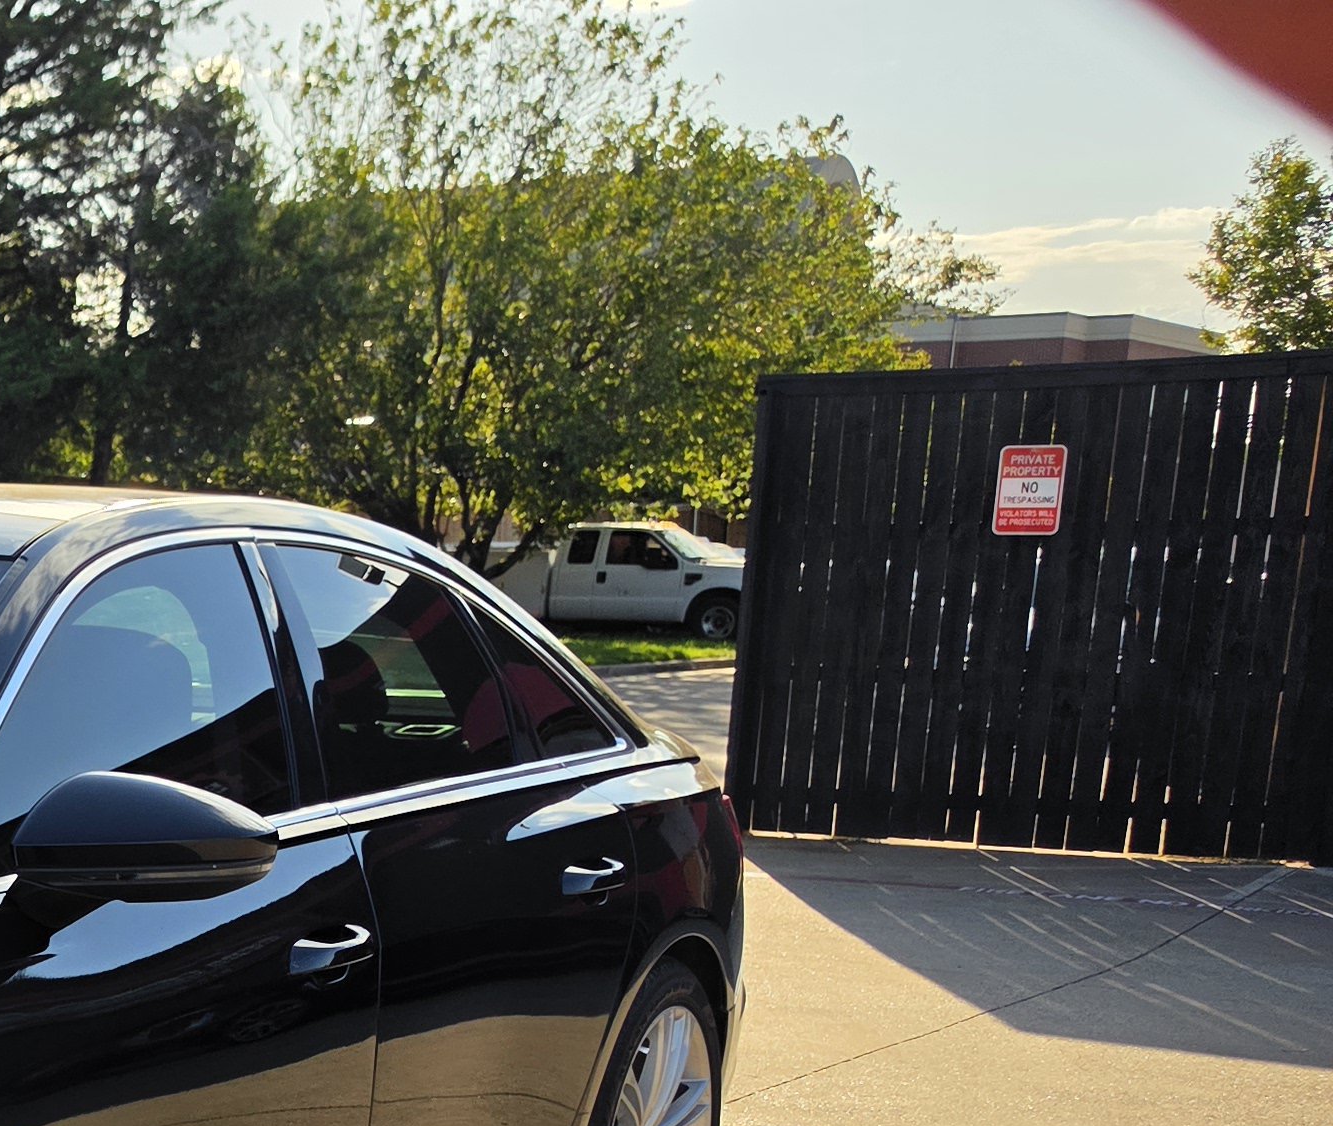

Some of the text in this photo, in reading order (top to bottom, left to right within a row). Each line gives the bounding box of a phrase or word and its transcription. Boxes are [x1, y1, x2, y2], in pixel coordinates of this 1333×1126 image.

[1011, 454, 1056, 465] PRIVATE
[1003, 466, 1061, 476] PROPERTY
[1021, 481, 1038, 494] NO
[1003, 495, 1054, 504] TRESPASSING
